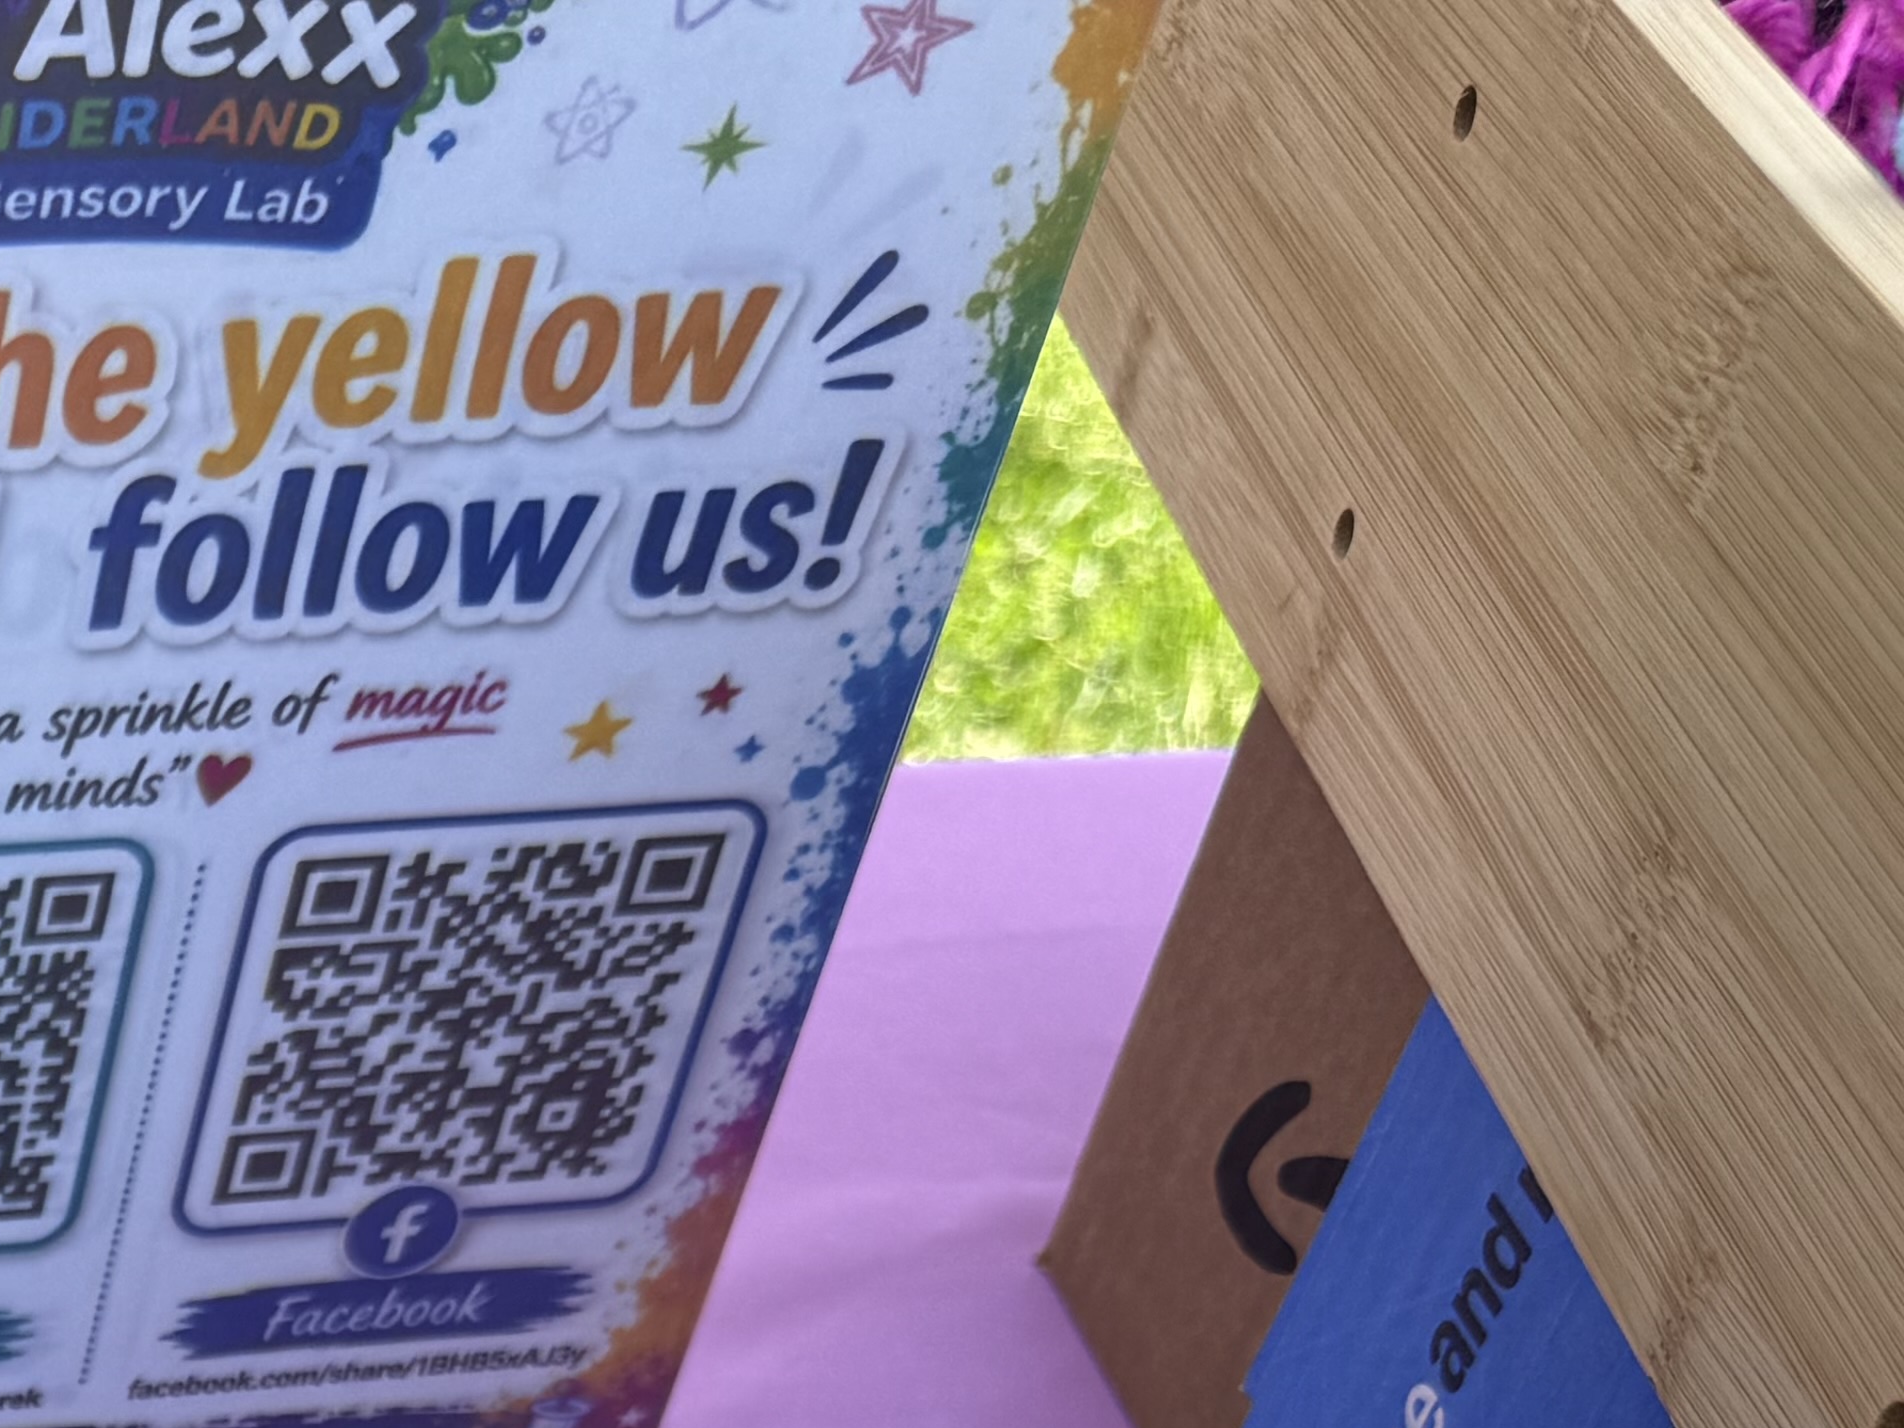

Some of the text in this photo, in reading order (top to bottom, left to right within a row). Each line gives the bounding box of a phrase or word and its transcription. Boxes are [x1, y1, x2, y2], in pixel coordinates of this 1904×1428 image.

[12, 0, 404, 89] Alexx
[223, 179, 328, 224] Lab
[198, 253, 781, 480] yellow
[87, 464, 601, 631] follow
[630, 439, 886, 598] us!
[43, 680, 252, 758] sprinkle
[270, 673, 340, 735] of
[345, 671, 510, 732] magic
[264, 1280, 492, 1343] Facebook
[1429, 1194, 1532, 1392] and
